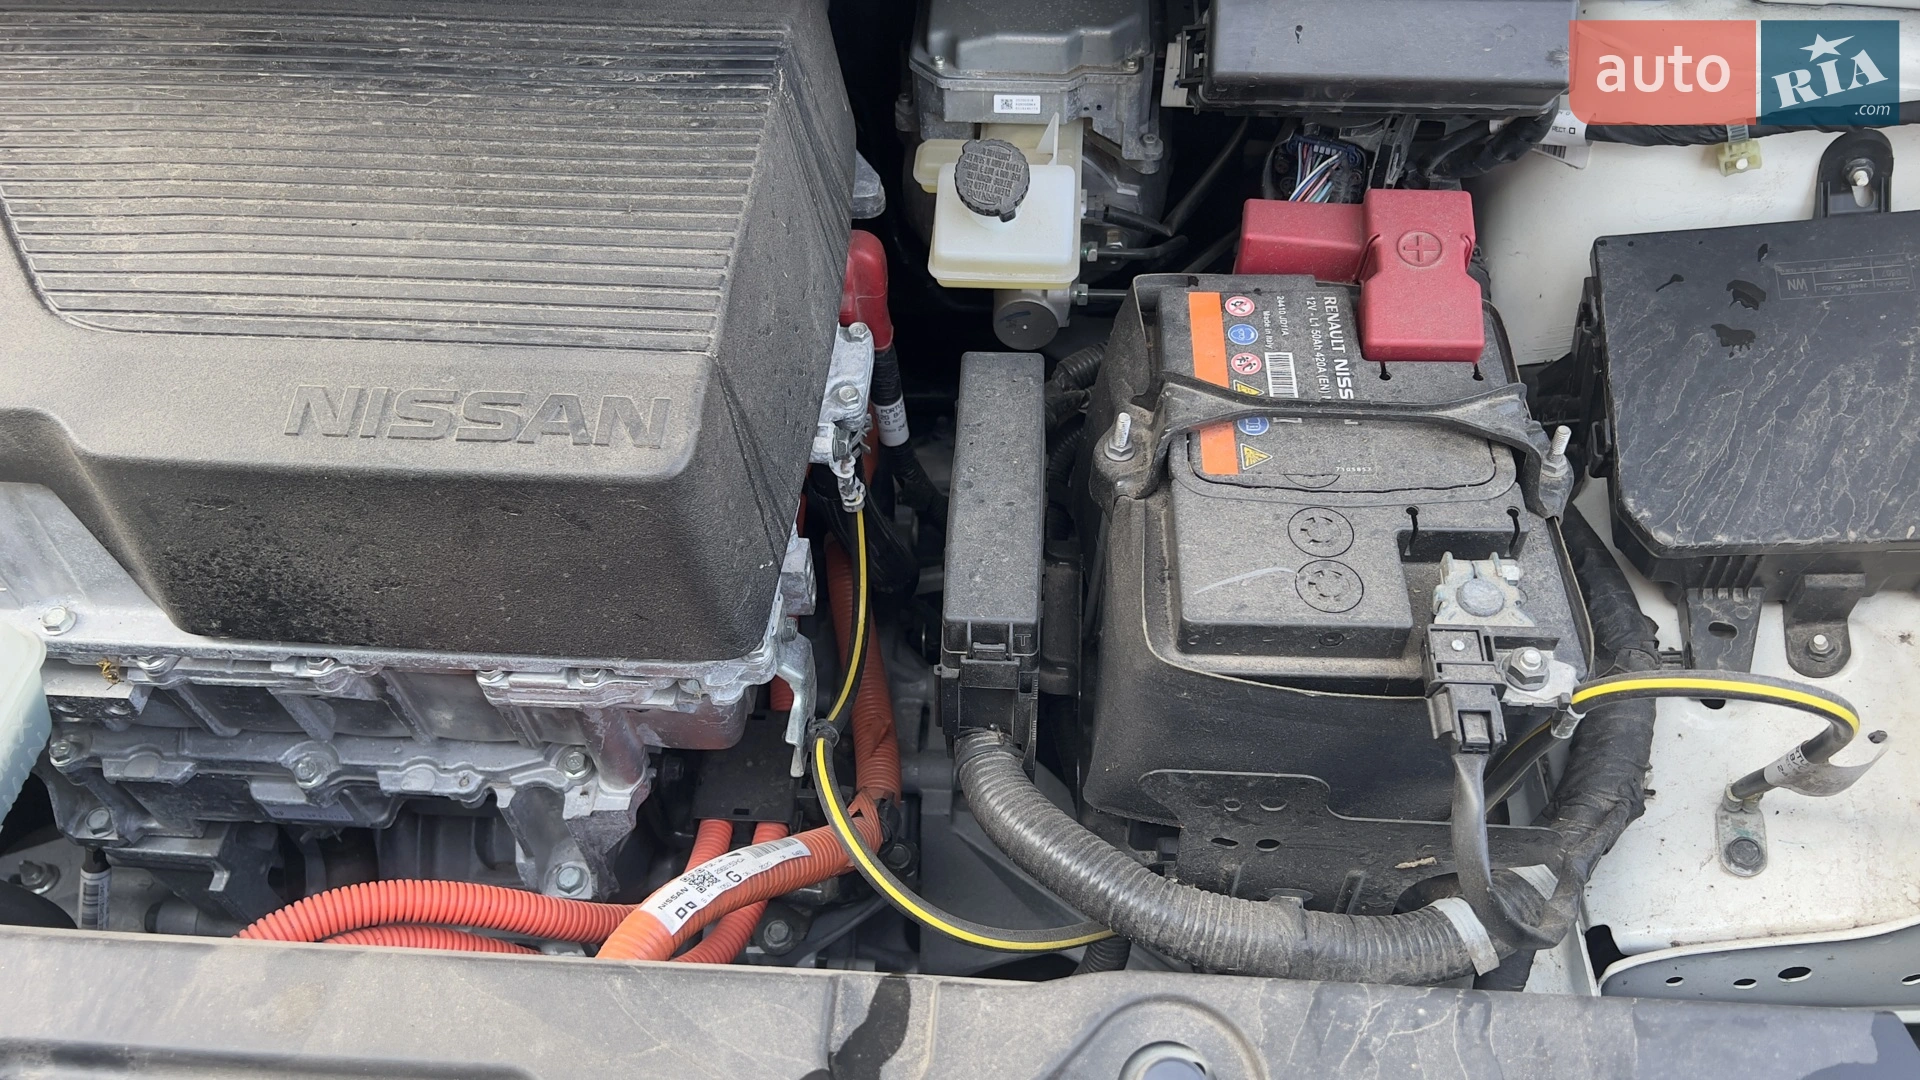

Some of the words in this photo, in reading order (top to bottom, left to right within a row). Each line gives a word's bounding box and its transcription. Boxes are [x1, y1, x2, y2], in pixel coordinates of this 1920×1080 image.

[1276, 295, 1286, 314] 24410
[1305, 296, 1317, 311] 12V
[1262, 310, 1271, 328] Made
[1309, 317, 1320, 327] L1
[1323, 296, 1346, 353] RENAULT
[1265, 335, 1275, 350] Italy
[1311, 329, 1323, 350] 50Ah
[1314, 352, 1328, 373] 420A
[1316, 375, 1331, 394] (EN)
[1333, 359, 1354, 400] NISS
[284, 384, 672, 449] NISSAN
[726, 870, 743, 883] G
[657, 886, 689, 911] NISSAN
